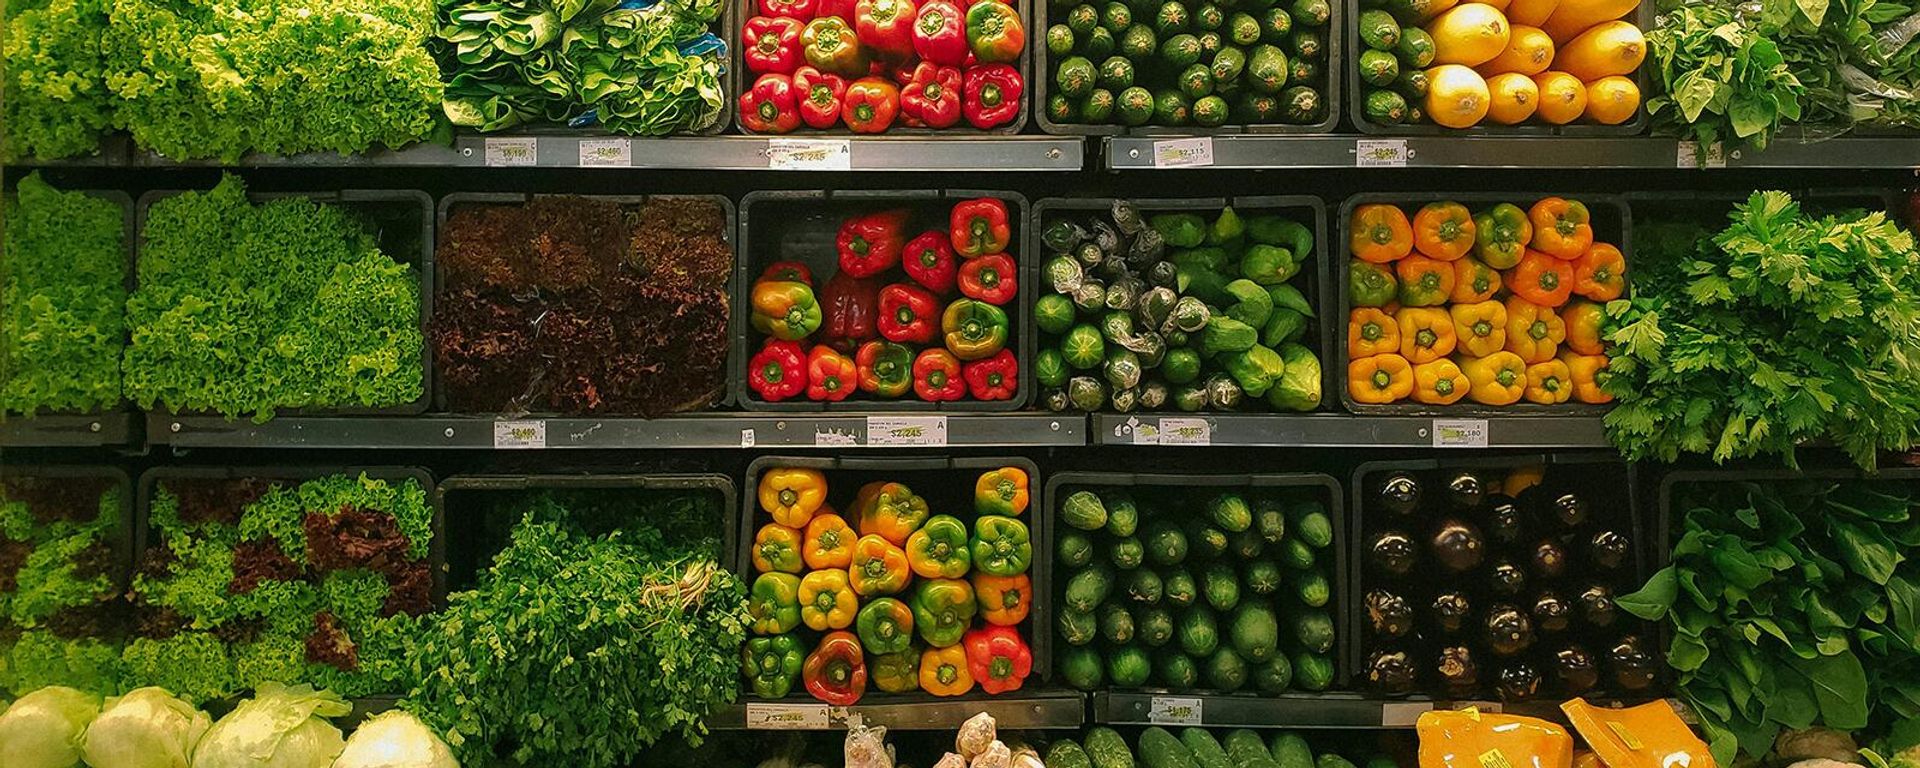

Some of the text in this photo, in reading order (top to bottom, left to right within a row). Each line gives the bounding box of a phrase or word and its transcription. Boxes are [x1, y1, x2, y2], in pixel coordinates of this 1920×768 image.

[841, 144, 849, 153] A
[937, 420, 945, 430] A
[890, 429, 922, 438] $2,245
[818, 708, 826, 716] A
